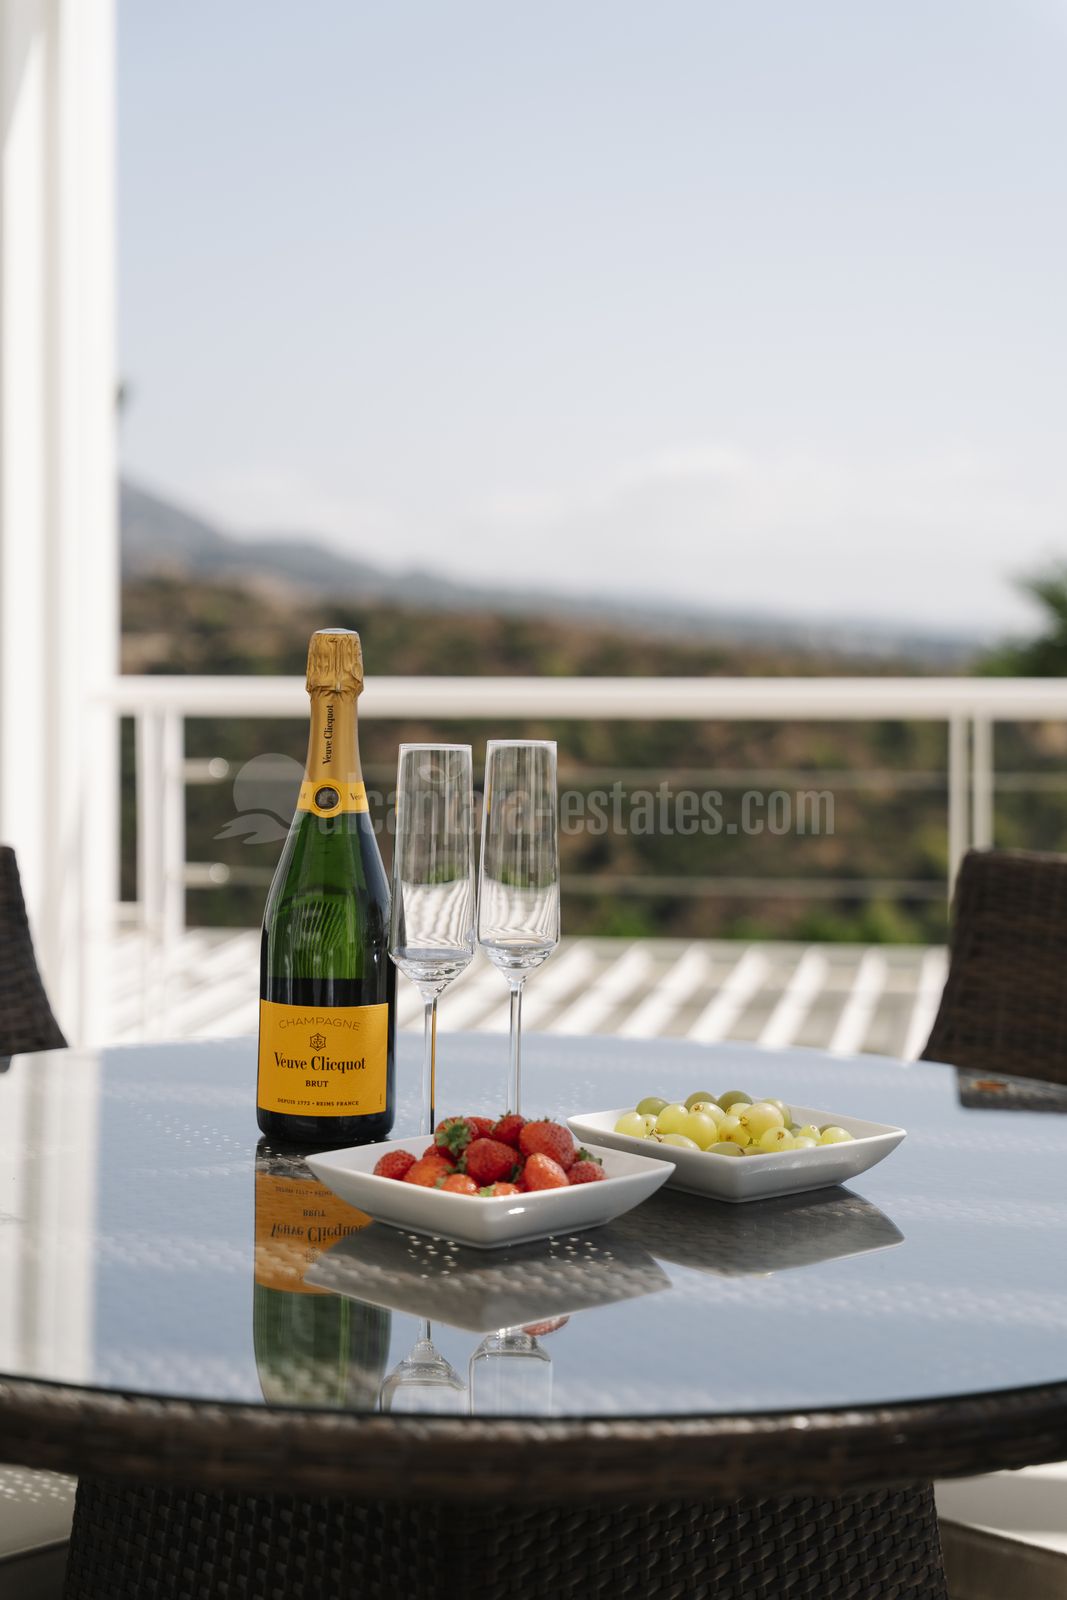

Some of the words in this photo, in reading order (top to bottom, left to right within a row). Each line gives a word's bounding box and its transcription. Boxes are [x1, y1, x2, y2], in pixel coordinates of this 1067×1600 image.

[323, 704, 335, 739] Clicquot
[322, 740, 333, 765] Veuve
[278, 1016, 361, 1032] CHAMPAGNE
[274, 1051, 308, 1071] Veuve
[311, 1055, 367, 1075] Clicquot
[305, 1079, 329, 1088] BRUT
[277, 1097, 296, 1105] DEPUIS
